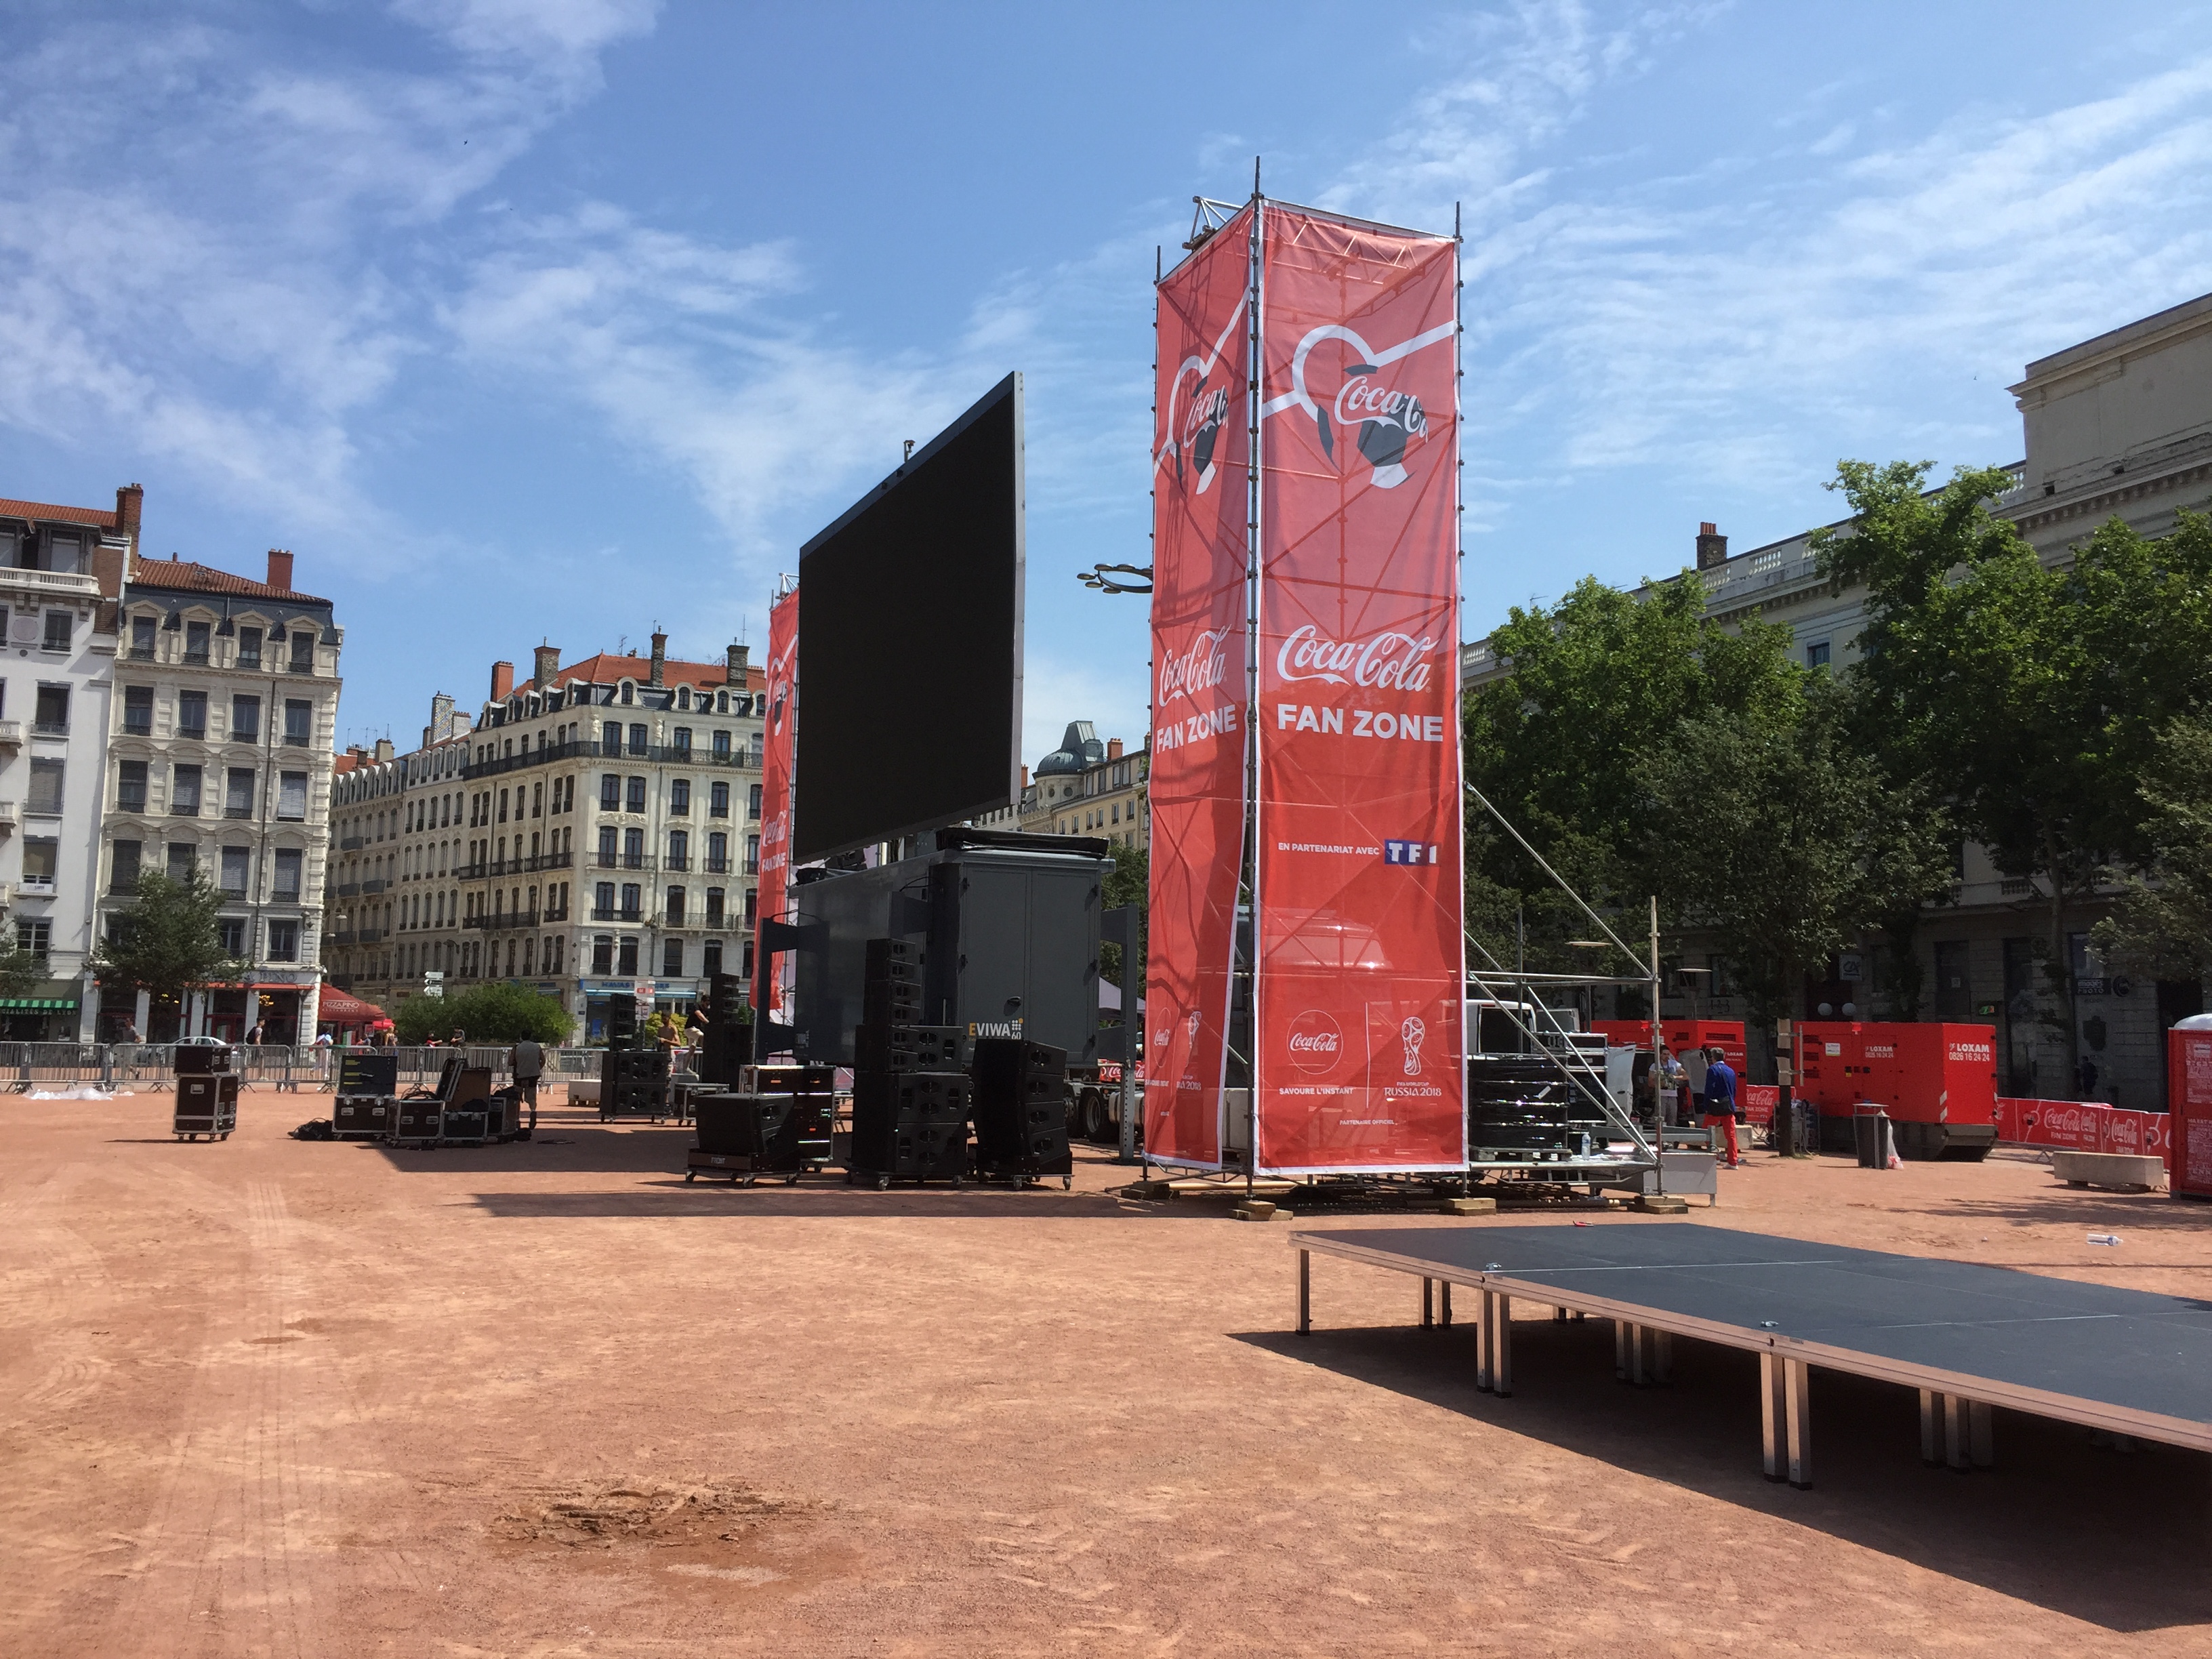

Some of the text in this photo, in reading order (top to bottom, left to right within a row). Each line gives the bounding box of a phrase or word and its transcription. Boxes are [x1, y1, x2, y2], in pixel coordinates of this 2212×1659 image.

[1159, 623, 1232, 707] Coca-Cola
[1277, 625, 1440, 692] Coca-Cola
[1157, 704, 1237, 754] FAN ZONE
[1277, 703, 1443, 742] FAN ZONE
[1278, 842, 1380, 855] EN PARTENARIAT AVEC
[1389, 842, 1437, 864] TF1
[968, 1022, 1022, 1040] EVIWA 60
[1290, 1032, 1340, 1051] Coca-Cola
[1957, 1043, 1990, 1052] LOXAM
[1948, 1052, 1990, 1062] 0826 16 24 24
[1385, 1087, 1442, 1097] RUSSIA 2018
[2051, 1131, 2062, 1139] FAN
[2062, 1132, 2077, 1141] ZONE
